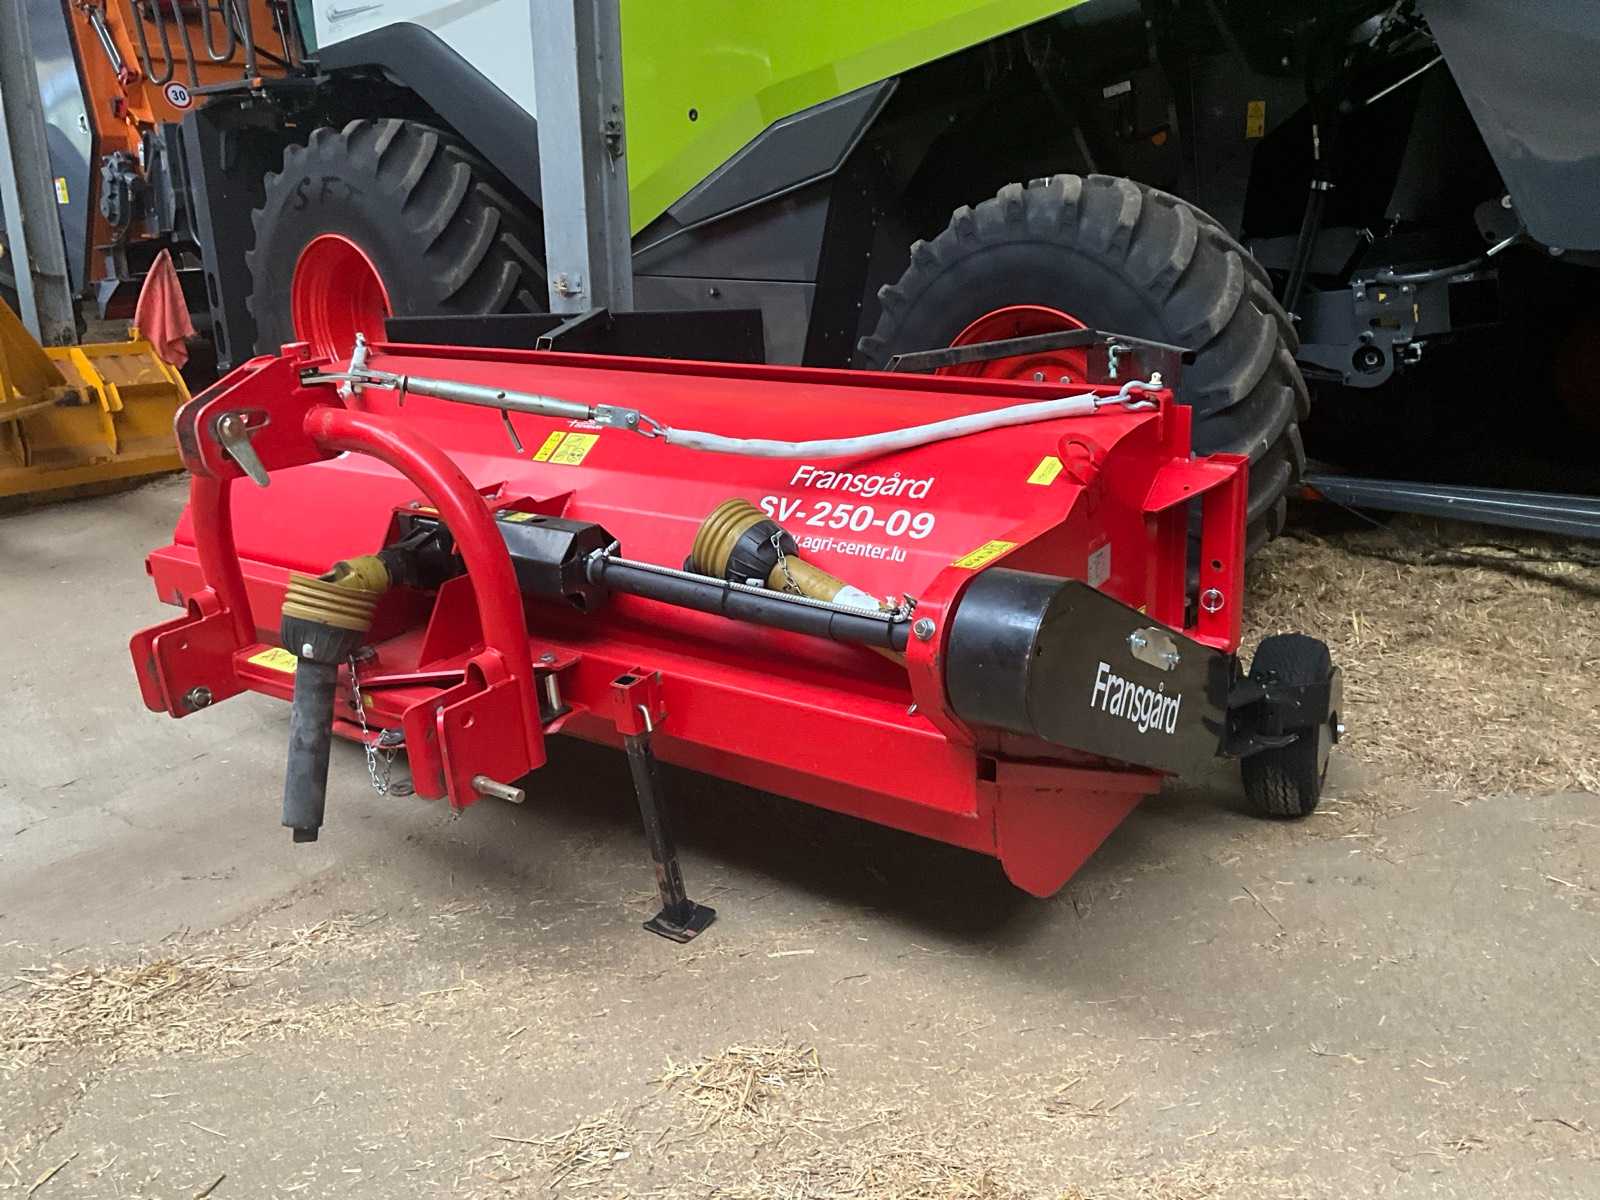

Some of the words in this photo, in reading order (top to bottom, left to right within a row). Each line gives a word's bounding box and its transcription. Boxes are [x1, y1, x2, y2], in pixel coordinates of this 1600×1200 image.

[172, 90, 186, 101] 30
[790, 465, 935, 499] Fransgård
[759, 495, 936, 540] SV-250-09
[1090, 661, 1182, 735] Fransgård
